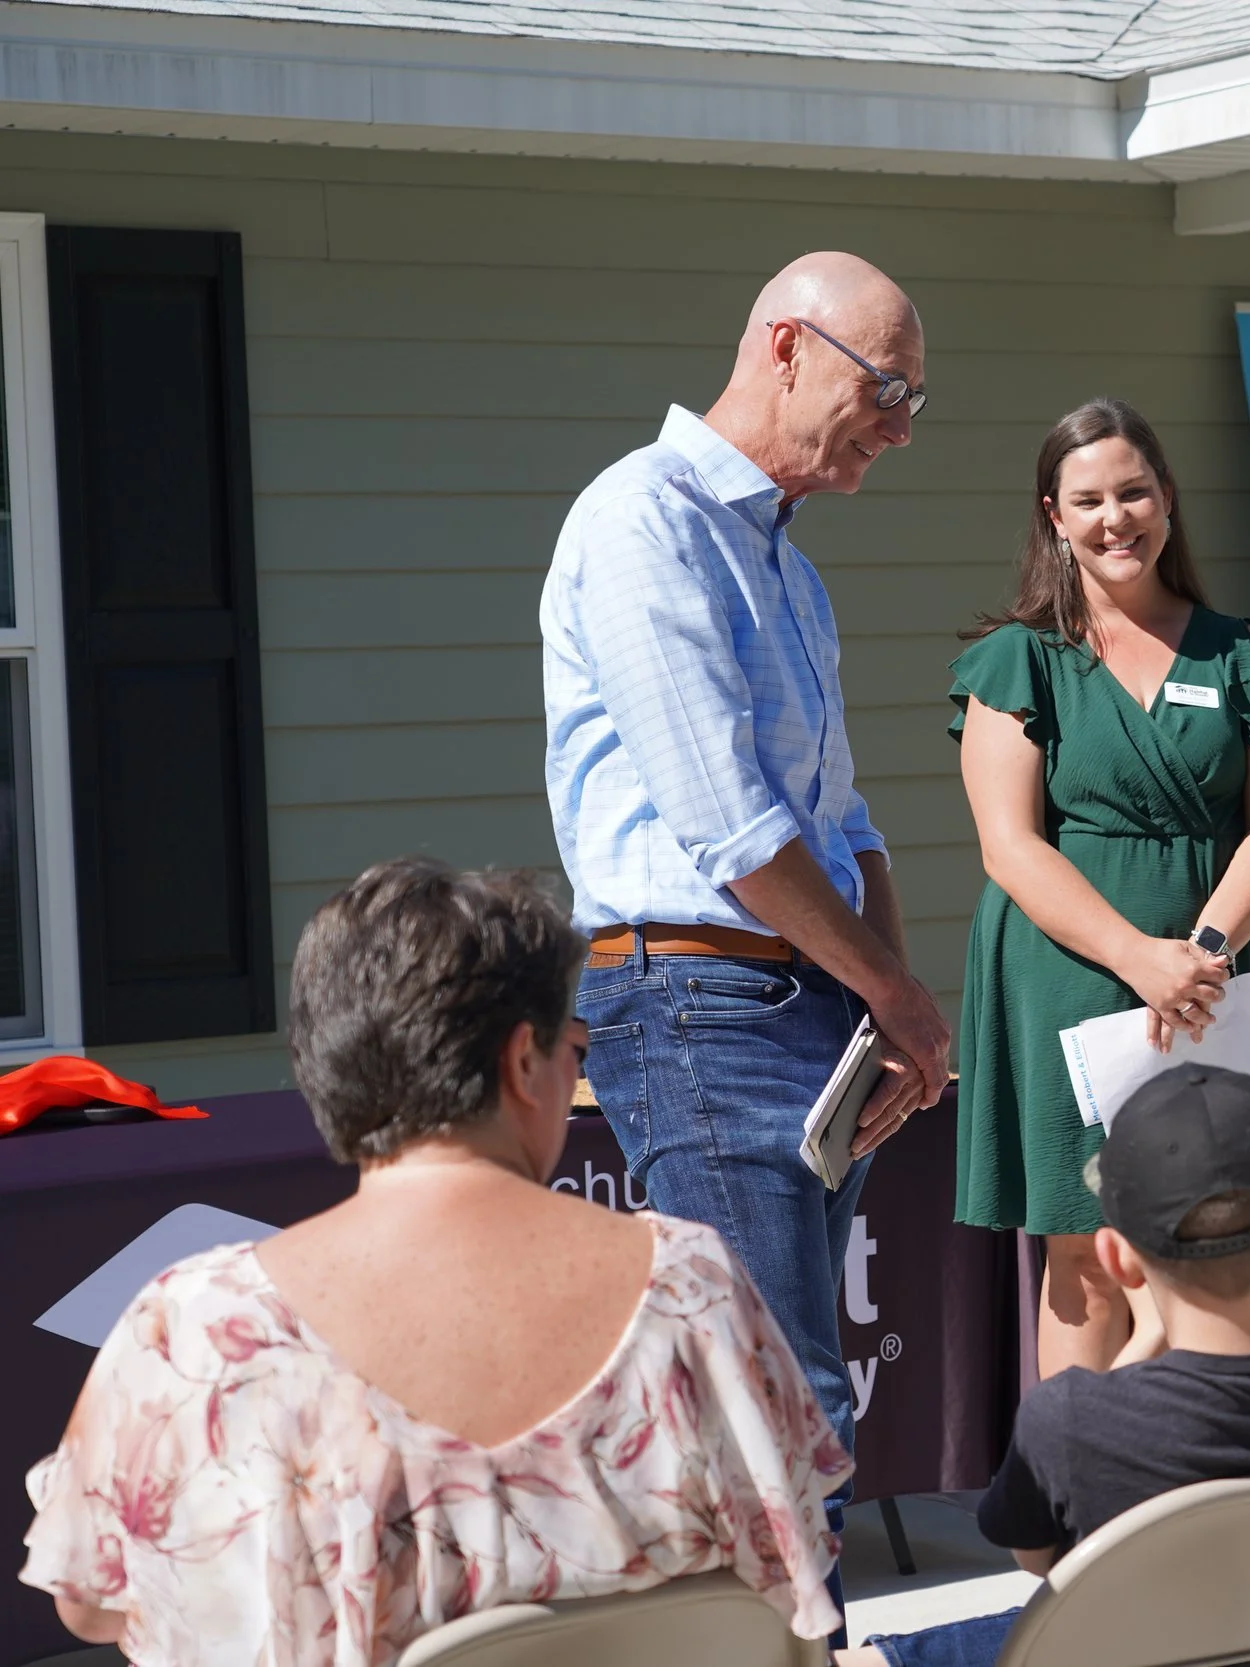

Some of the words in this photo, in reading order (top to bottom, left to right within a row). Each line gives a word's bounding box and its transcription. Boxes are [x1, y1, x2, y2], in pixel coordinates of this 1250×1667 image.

[1071, 1034, 1083, 1060] Elliott
[1081, 1070, 1094, 1099] Robert
[1089, 1101, 1101, 1121] Meet
